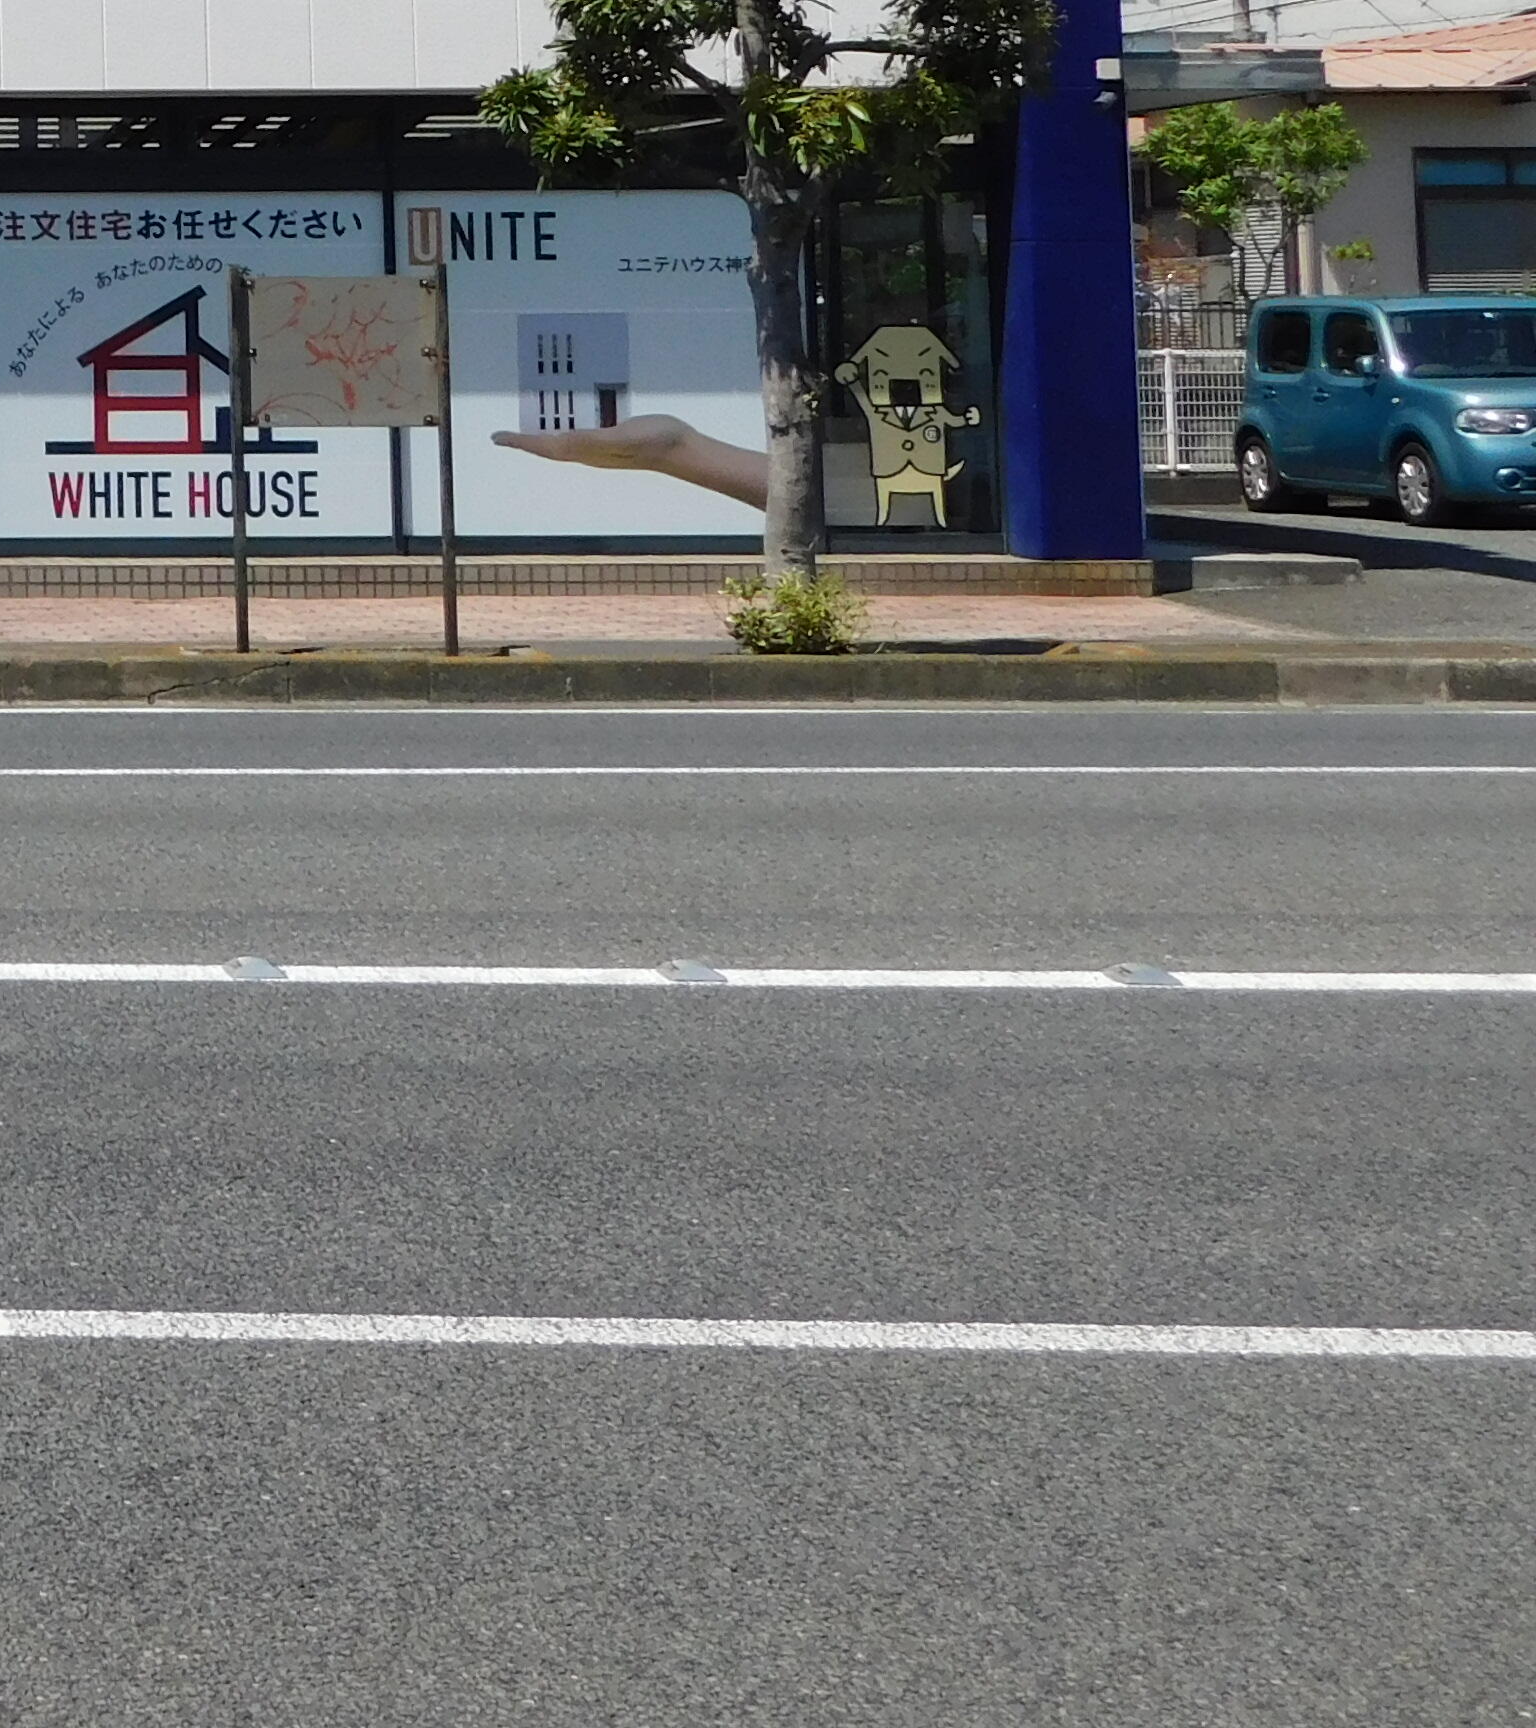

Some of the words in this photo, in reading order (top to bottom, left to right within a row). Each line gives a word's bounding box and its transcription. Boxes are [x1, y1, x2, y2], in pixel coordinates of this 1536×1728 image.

[410, 208, 558, 263] UNITE
[8, 285, 87, 378] あなたによる
[95, 252, 224, 290] あなたのための
[48, 470, 173, 519] WHITE
[188, 470, 320, 518] HOUSE
